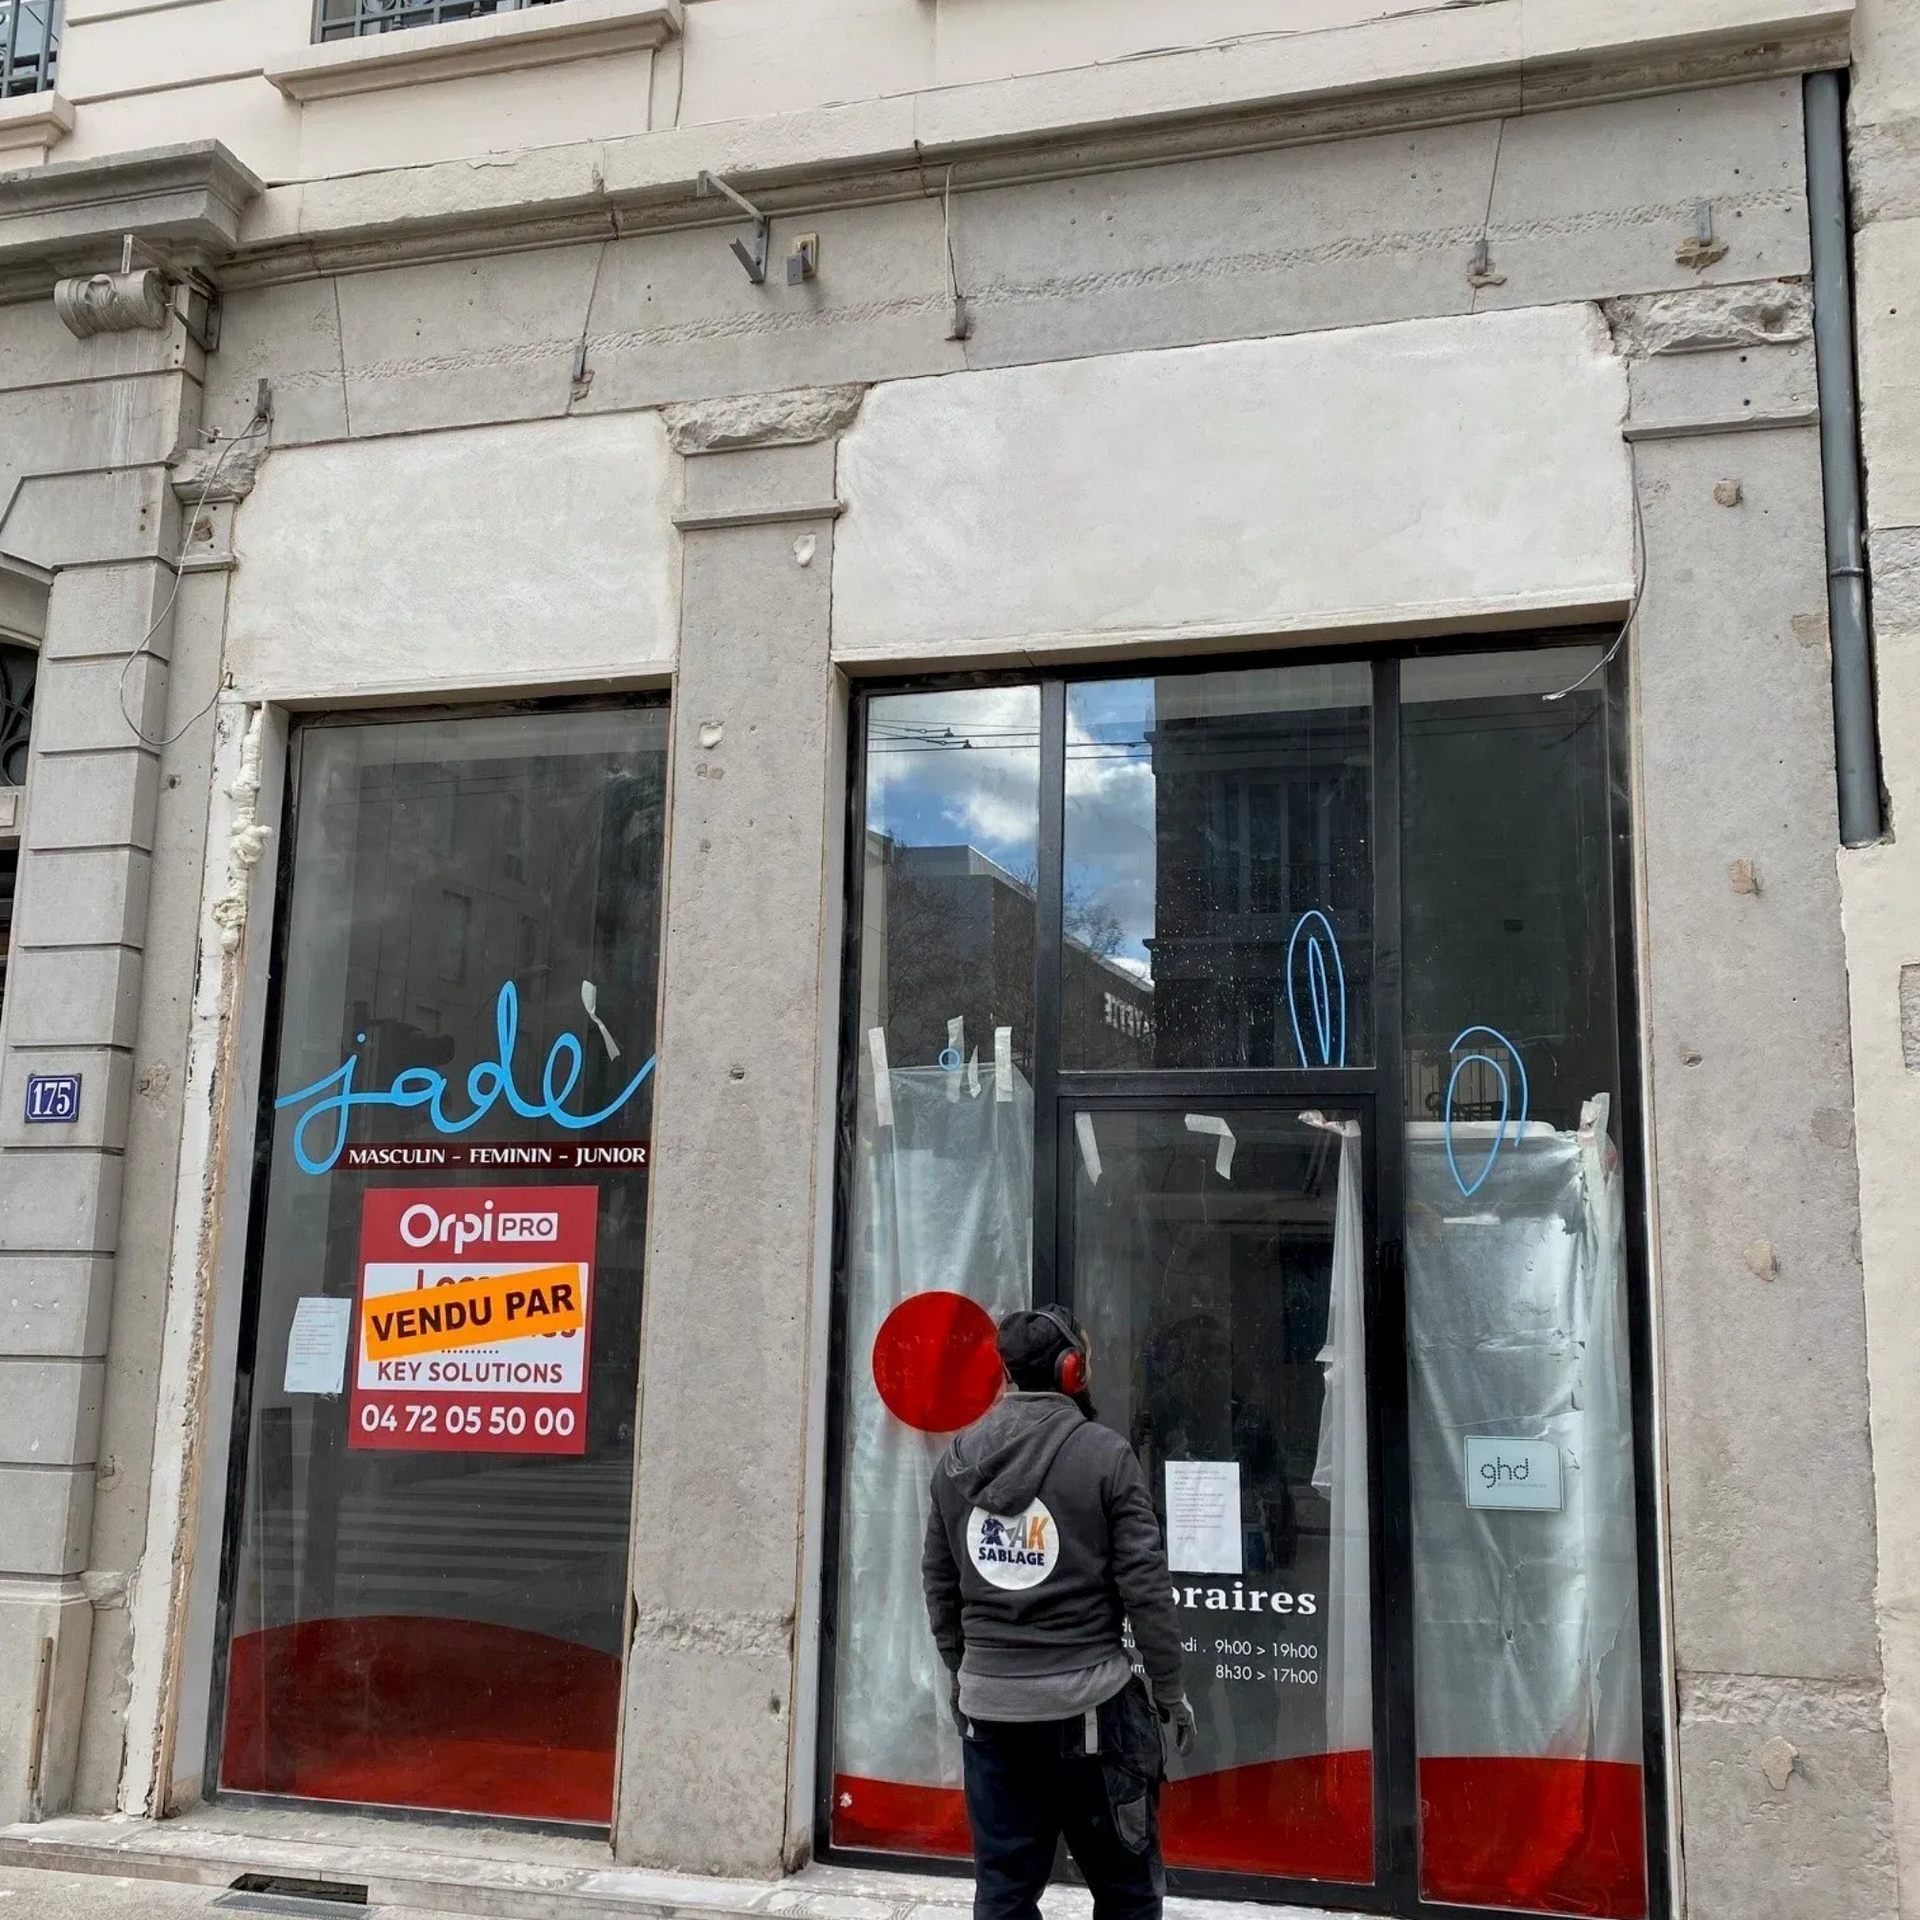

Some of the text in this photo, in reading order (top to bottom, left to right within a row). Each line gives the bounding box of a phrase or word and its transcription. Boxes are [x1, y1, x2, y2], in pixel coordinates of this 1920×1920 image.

[32, 1082, 71, 1115] 175
[349, 1148, 446, 1164] MASCULIN
[469, 1147, 552, 1164] FEMININ
[574, 1147, 647, 1167] JUNIOR
[400, 1199, 554, 1254] Orpi PRO
[371, 1296, 493, 1342] VENDU
[505, 1283, 575, 1321] PAR
[377, 1361, 563, 1384] KEY SOLUTIONS
[361, 1403, 575, 1436] 04 72 05 50 00
[1480, 1456, 1529, 1488] ghd
[1009, 1514, 1049, 1550] AK
[978, 1546, 1045, 1566] SABLAGE
[1171, 1580, 1317, 1615] raires
[1214, 1638, 1251, 1656] 9h00
[1272, 1642, 1318, 1659] 19h00
[1215, 1664, 1252, 1681] 8h30
[1272, 1667, 1318, 1685] 17h00
